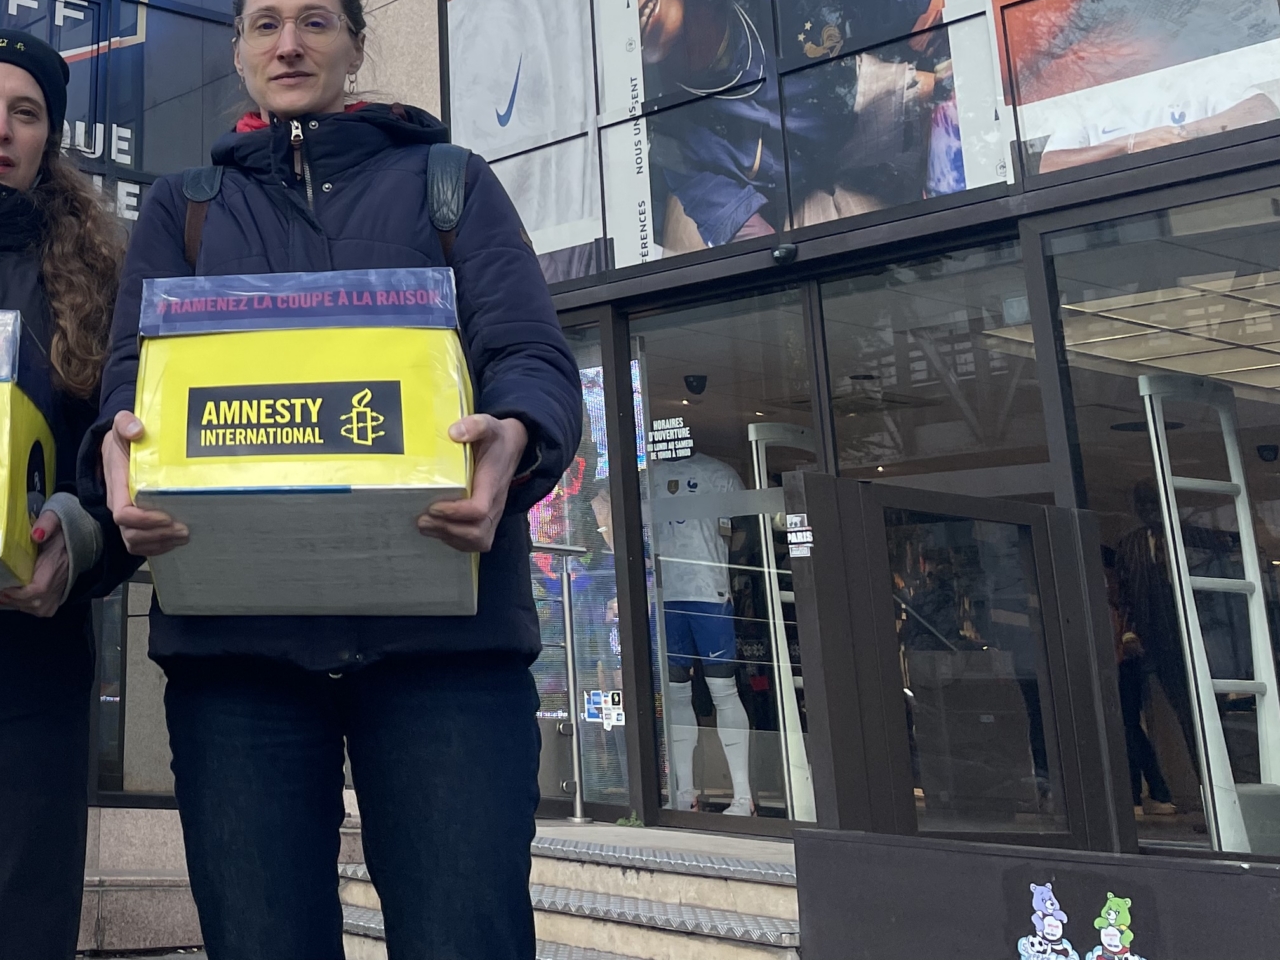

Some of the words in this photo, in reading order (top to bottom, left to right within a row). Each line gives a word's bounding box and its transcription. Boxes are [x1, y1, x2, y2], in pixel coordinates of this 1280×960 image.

[635, 139, 644, 175] NOUS
[253, 295, 272, 309] LA
[277, 292, 333, 309] COUPE
[338, 288, 349, 305] À
[352, 290, 373, 306] LA
[376, 289, 440, 306] RAISON
[201, 397, 323, 425] AMNESTY
[648, 426, 691, 442] D'OUVERTURE
[653, 417, 684, 431] HORAIRES
[200, 426, 324, 447] INTERNATIONAL
[787, 530, 813, 544] PARIS
